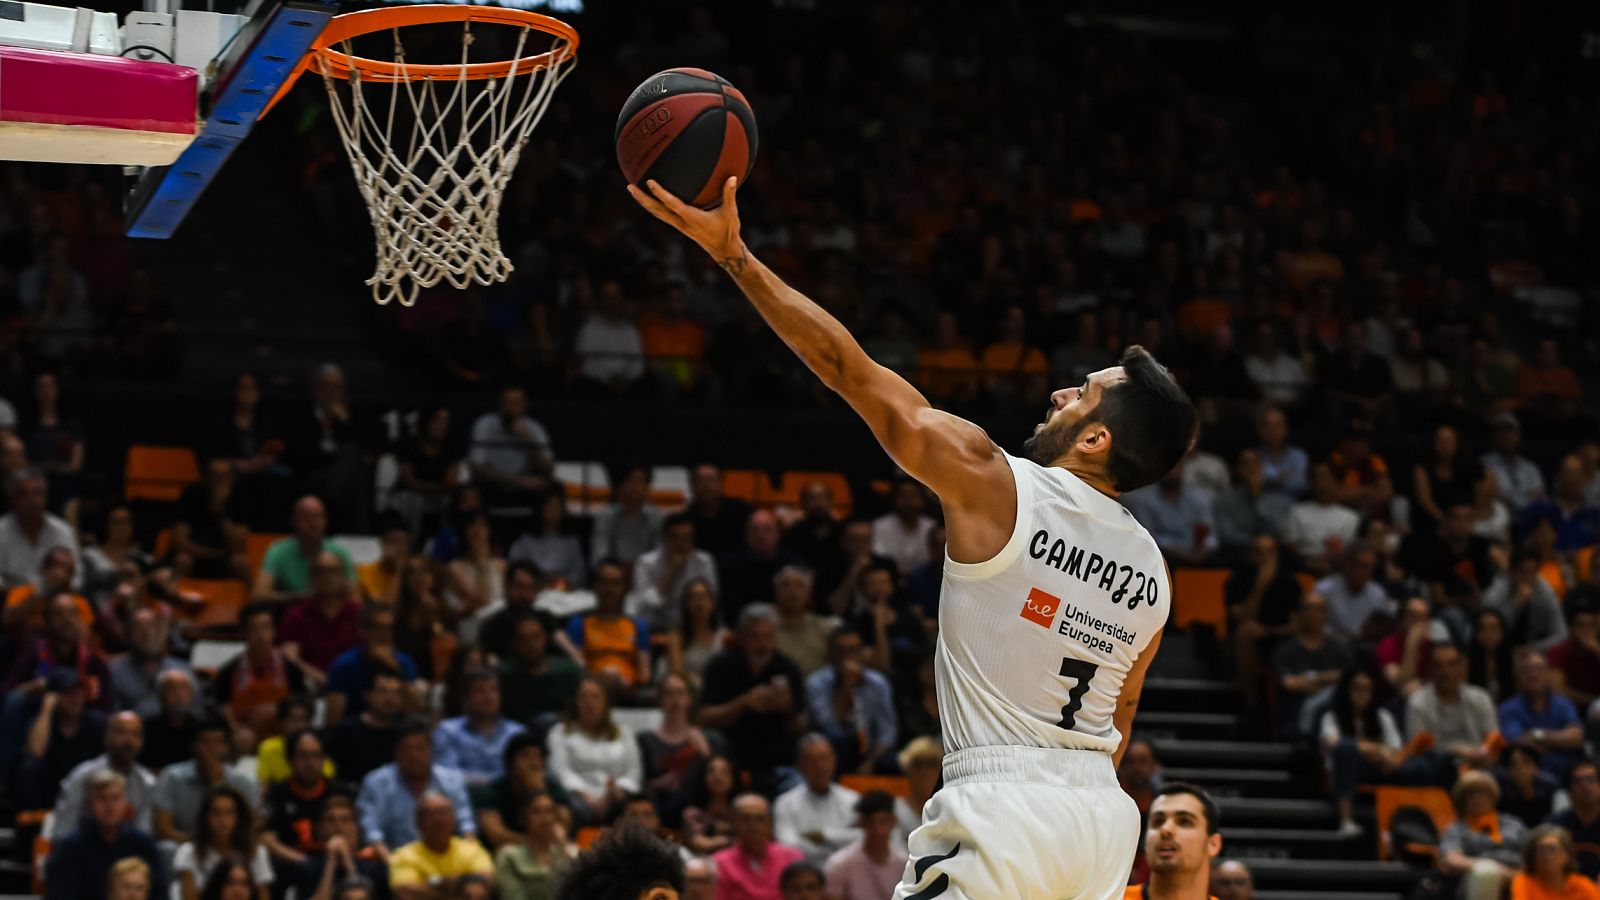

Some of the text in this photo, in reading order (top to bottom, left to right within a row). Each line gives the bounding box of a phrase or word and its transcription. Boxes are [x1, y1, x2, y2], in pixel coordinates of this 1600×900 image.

[1029, 529, 1158, 610] CAMPAZZO
[1058, 620, 1114, 654] Europea
[1065, 603, 1137, 645] Universidad
[1056, 656, 1099, 730] 7
